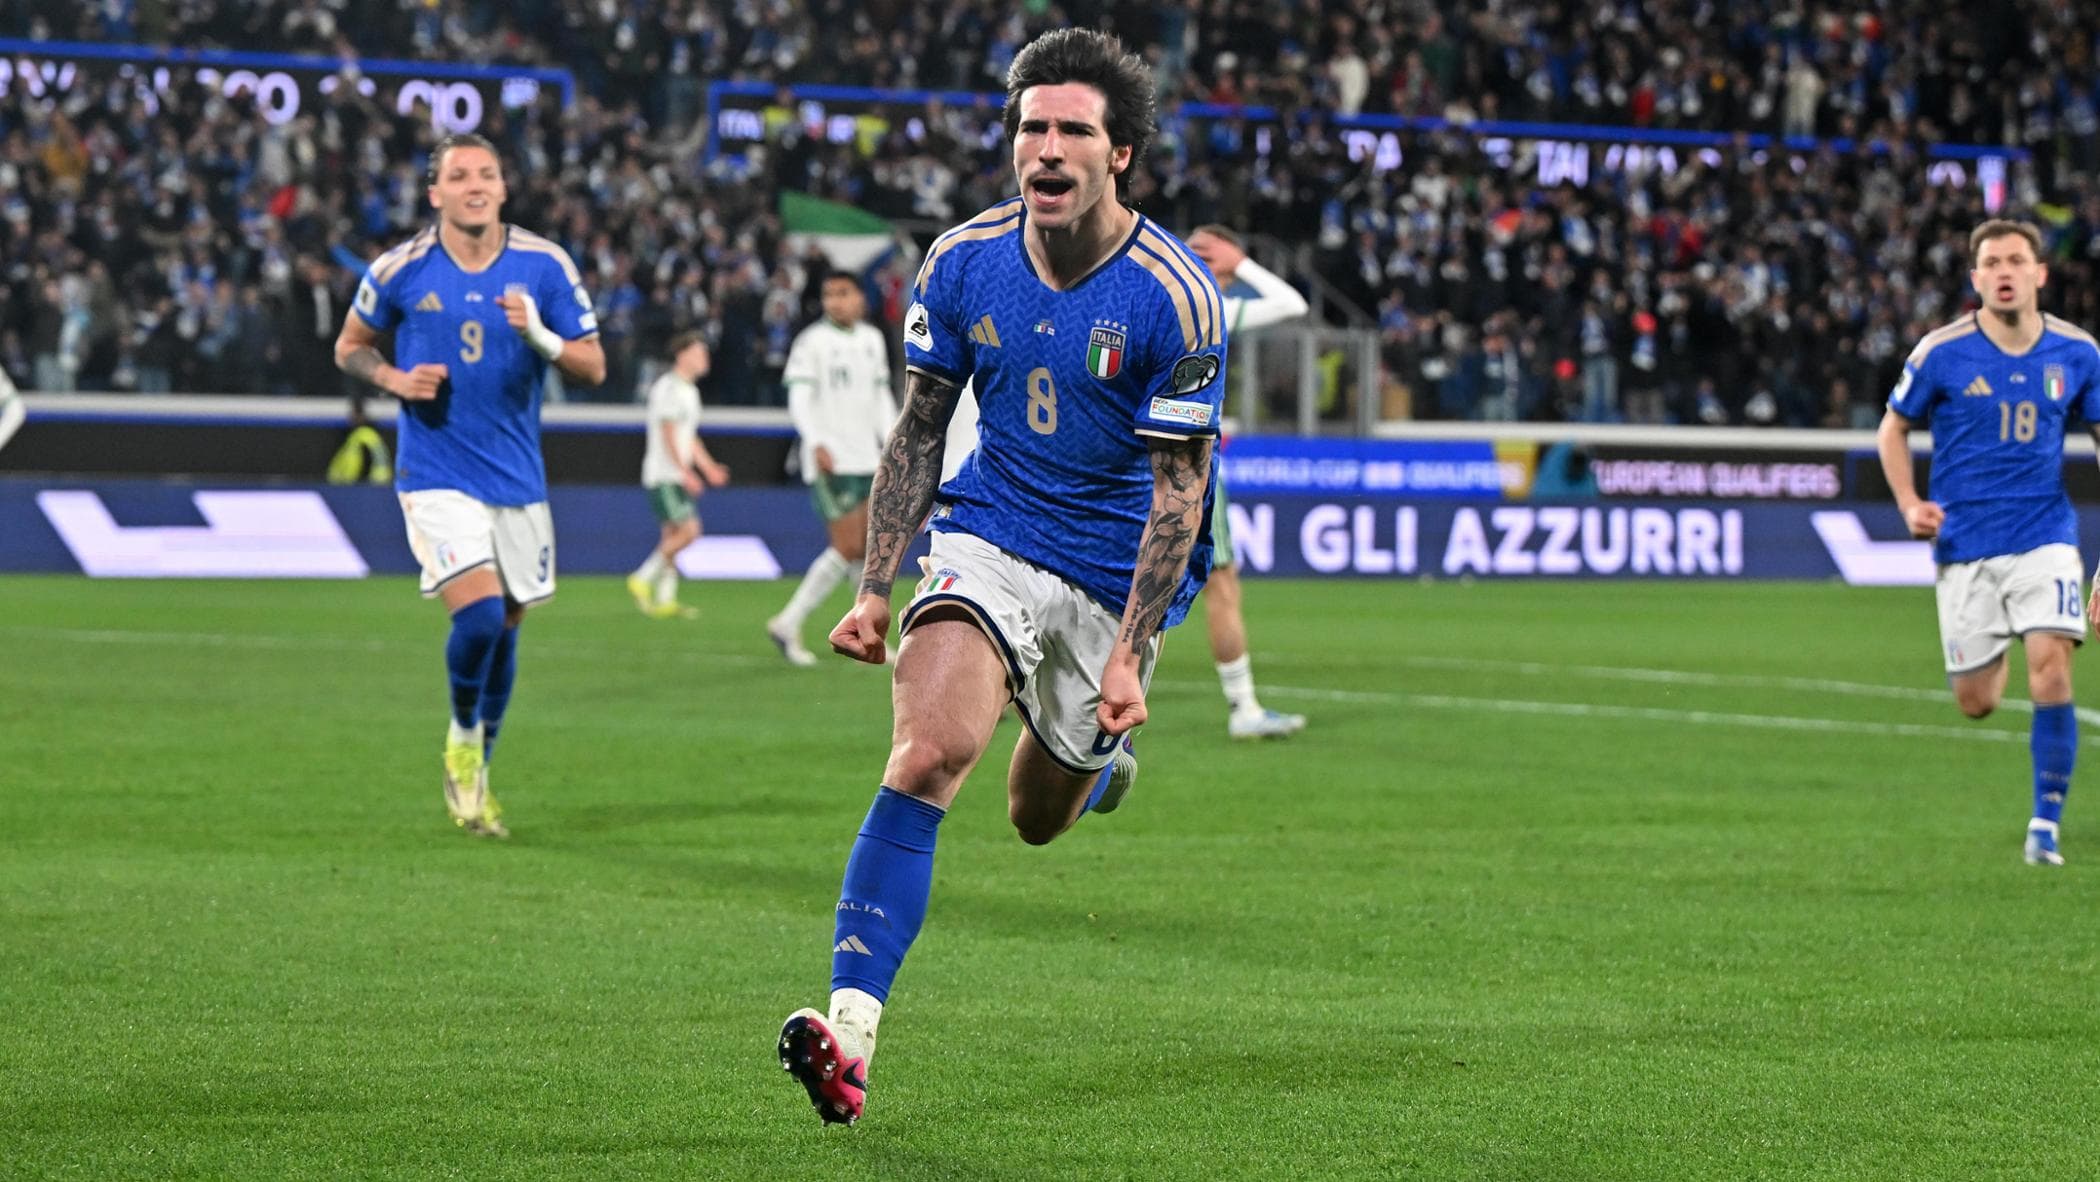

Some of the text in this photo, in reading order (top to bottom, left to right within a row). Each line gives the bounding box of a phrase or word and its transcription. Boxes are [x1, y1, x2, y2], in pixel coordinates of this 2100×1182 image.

[460, 320, 483, 363] 9
[1092, 329, 1122, 347] ITALIA
[1027, 367, 1057, 435] 8
[2000, 401, 2038, 443] 18
[1300, 504, 1419, 573] GLI
[1442, 506, 1743, 575] AZZURRI
[536, 546, 551, 583] 9
[2054, 577, 2082, 618] 18
